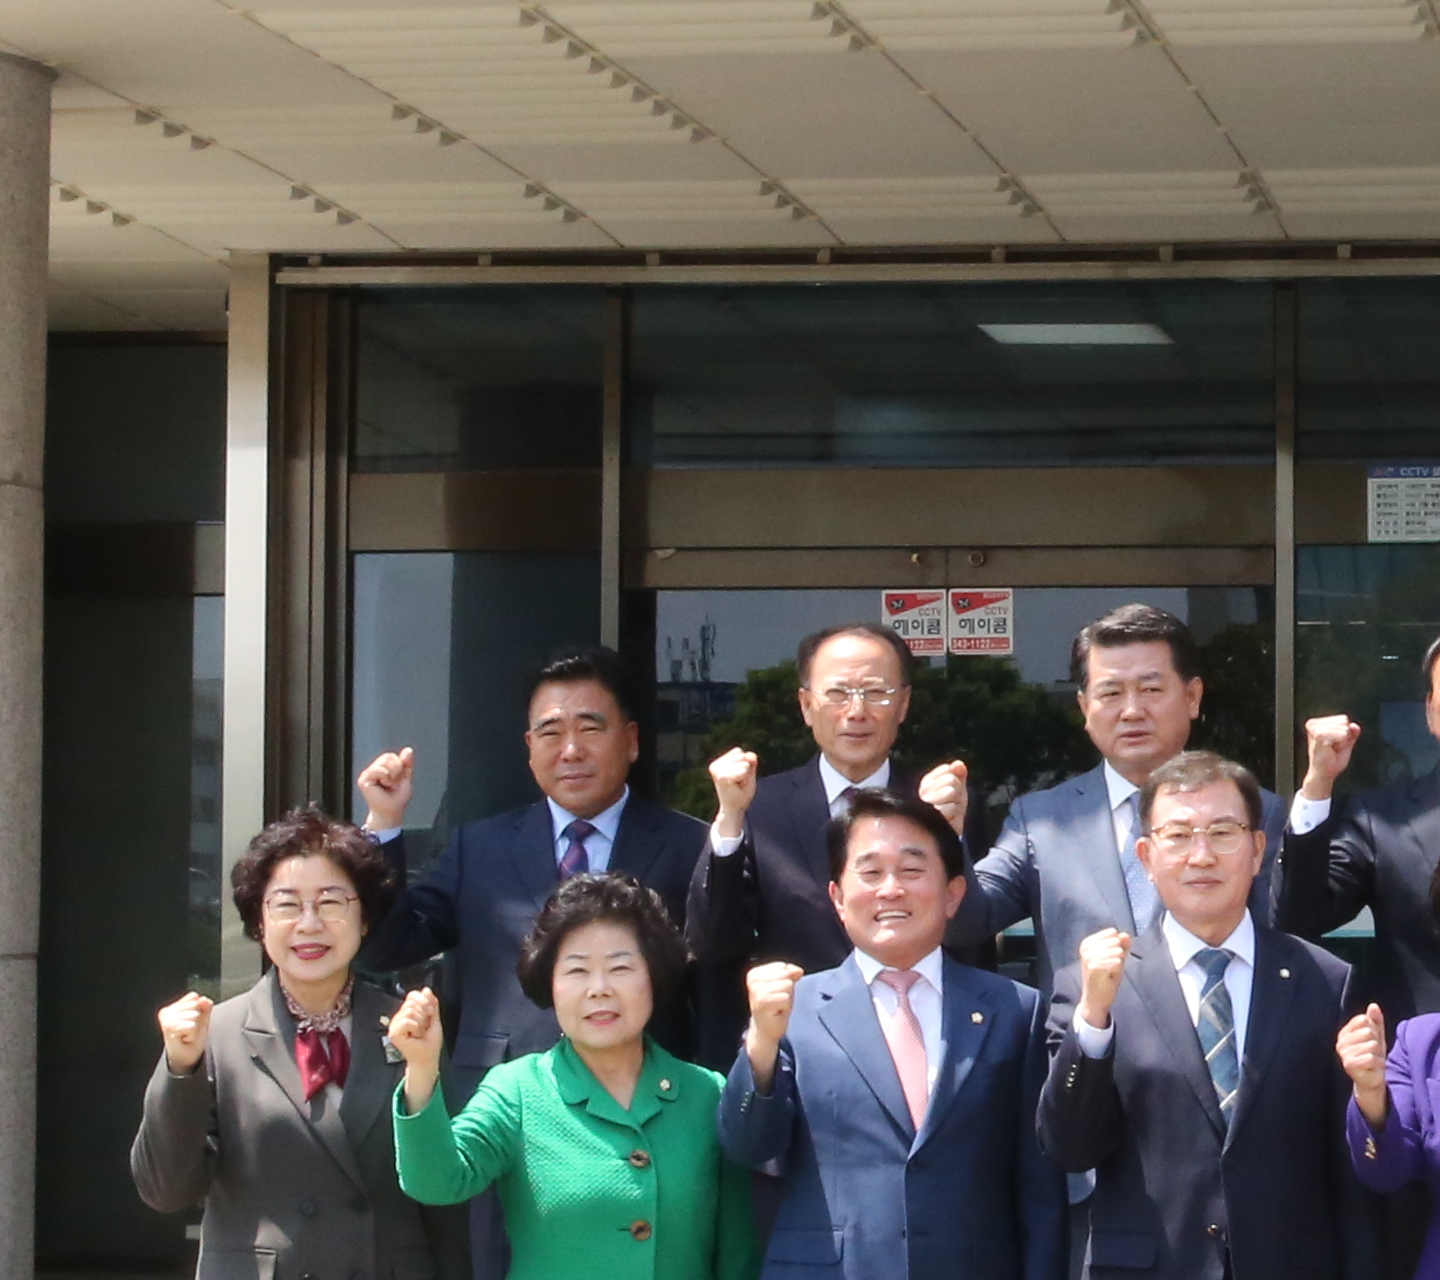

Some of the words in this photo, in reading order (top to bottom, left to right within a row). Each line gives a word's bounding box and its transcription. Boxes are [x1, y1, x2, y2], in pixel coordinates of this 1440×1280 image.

[1400, 466, 1429, 477] CCTV
[918, 607, 941, 616] CCTV
[984, 606, 1008, 615] CCTV
